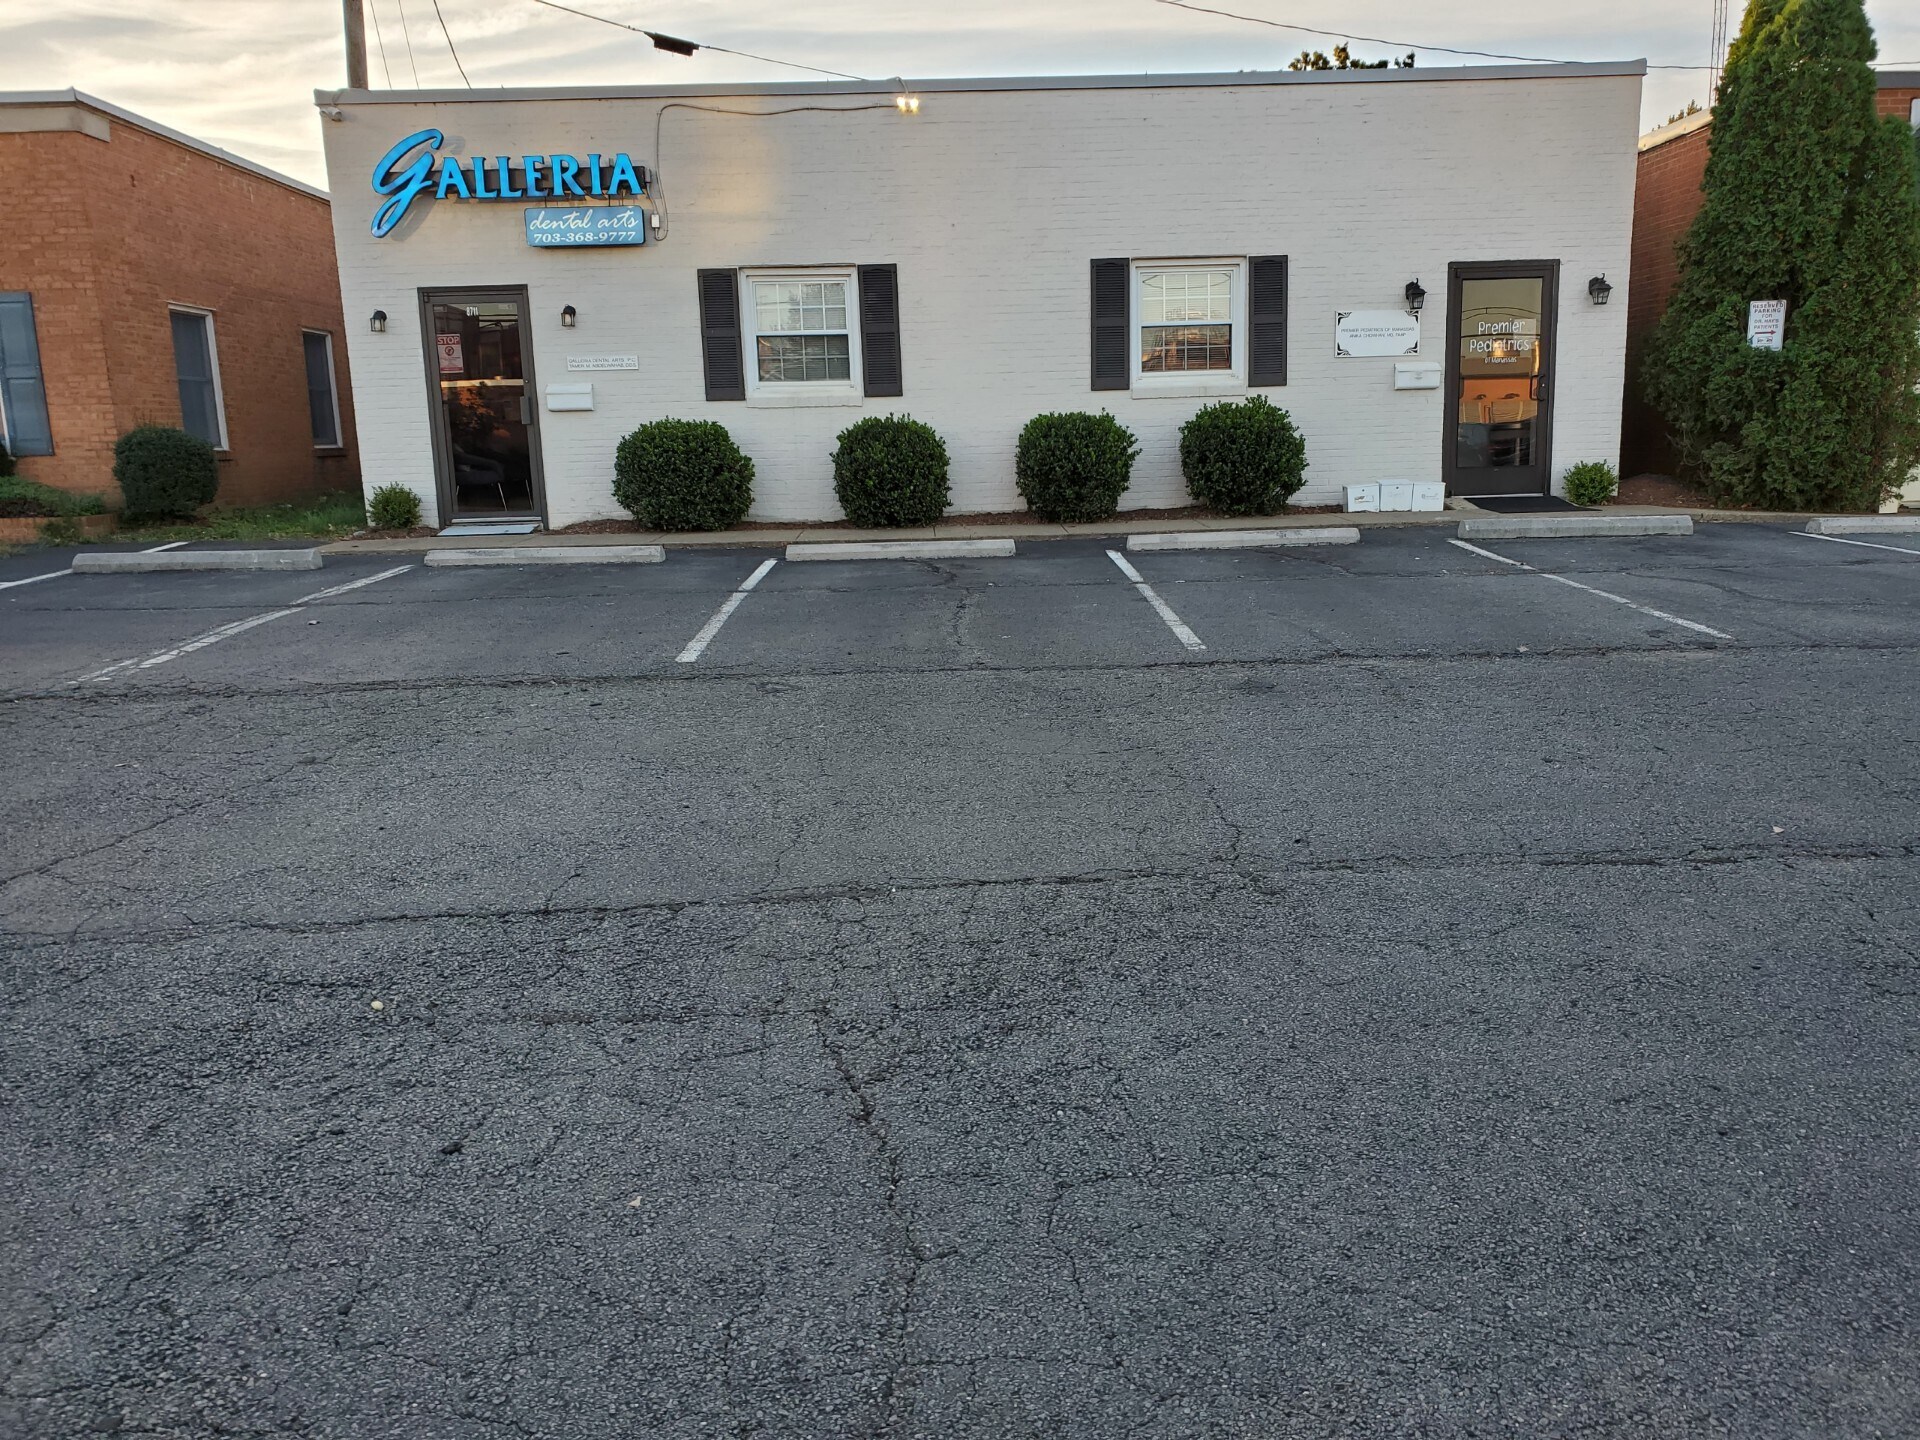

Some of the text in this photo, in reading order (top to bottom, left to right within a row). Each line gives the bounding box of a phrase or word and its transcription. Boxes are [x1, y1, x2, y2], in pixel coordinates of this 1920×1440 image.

[371, 128, 646, 239] GALLERIA
[529, 209, 639, 230] dental arts
[533, 231, 636, 243] 703-368-9777
[1478, 318, 1526, 335] Premier
[437, 336, 460, 345] STOP
[1469, 336, 1530, 353] Pediatrics
